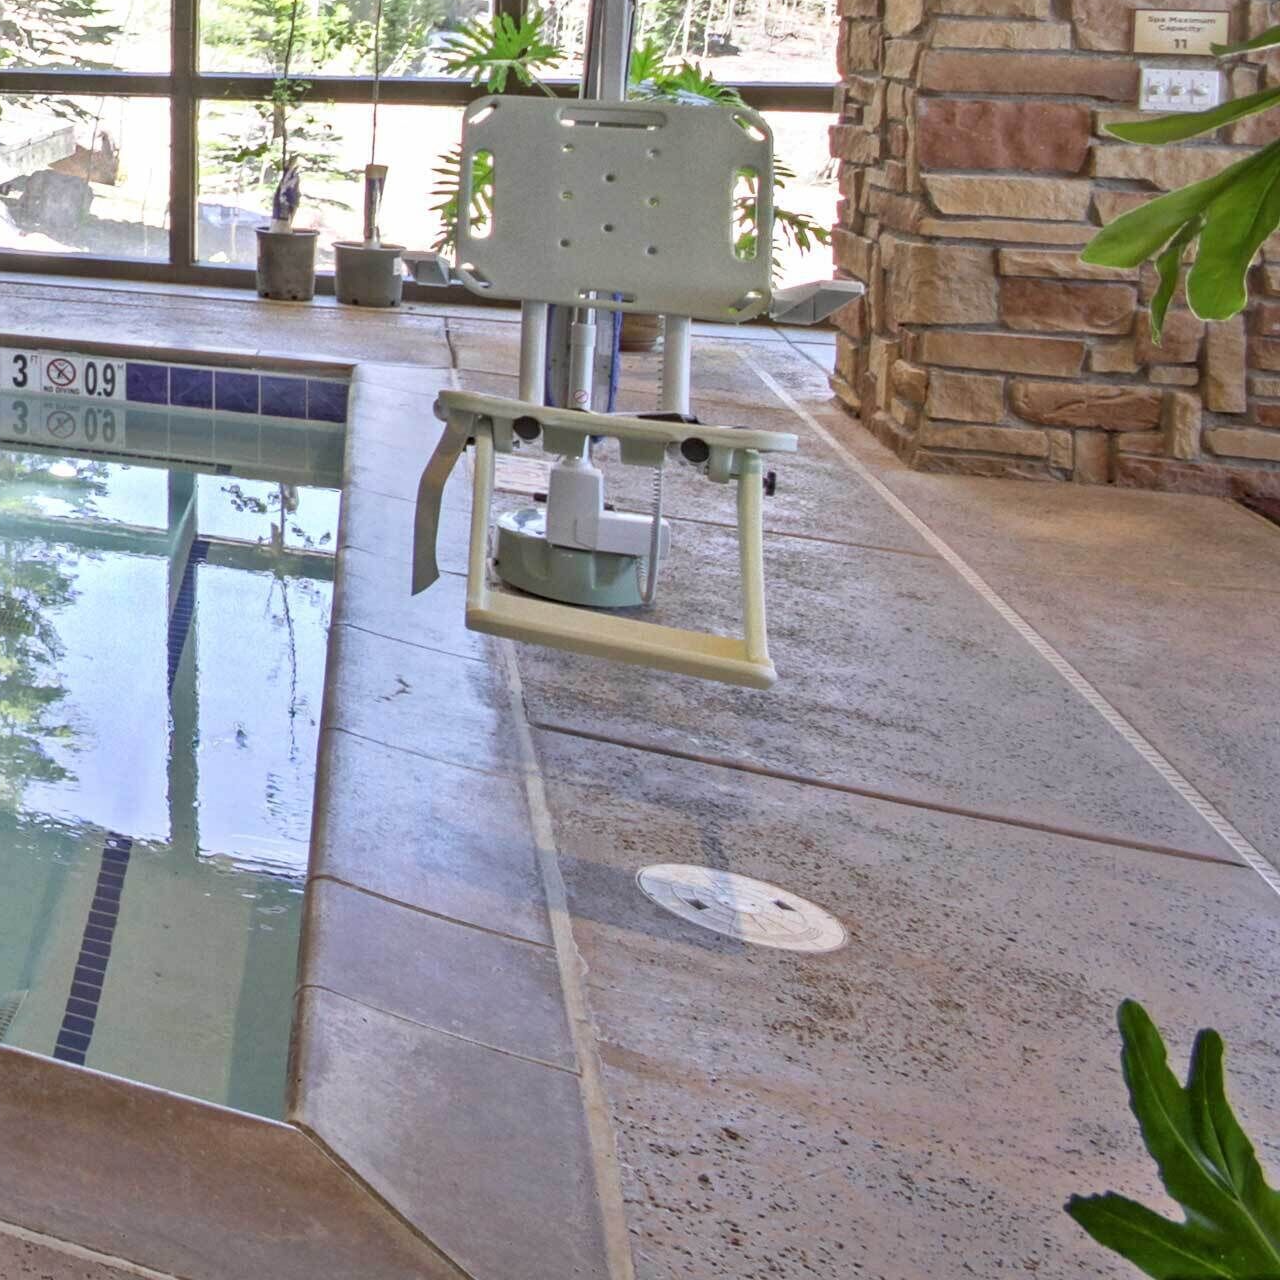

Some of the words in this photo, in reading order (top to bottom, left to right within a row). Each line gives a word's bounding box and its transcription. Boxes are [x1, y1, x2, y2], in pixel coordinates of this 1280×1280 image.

[1147, 16, 1166, 24] Spa
[1174, 39, 1187, 49] 11
[12, 354, 28, 388] 3
[85, 361, 116, 397] 0.9
[55, 387, 80, 395] DIVING
